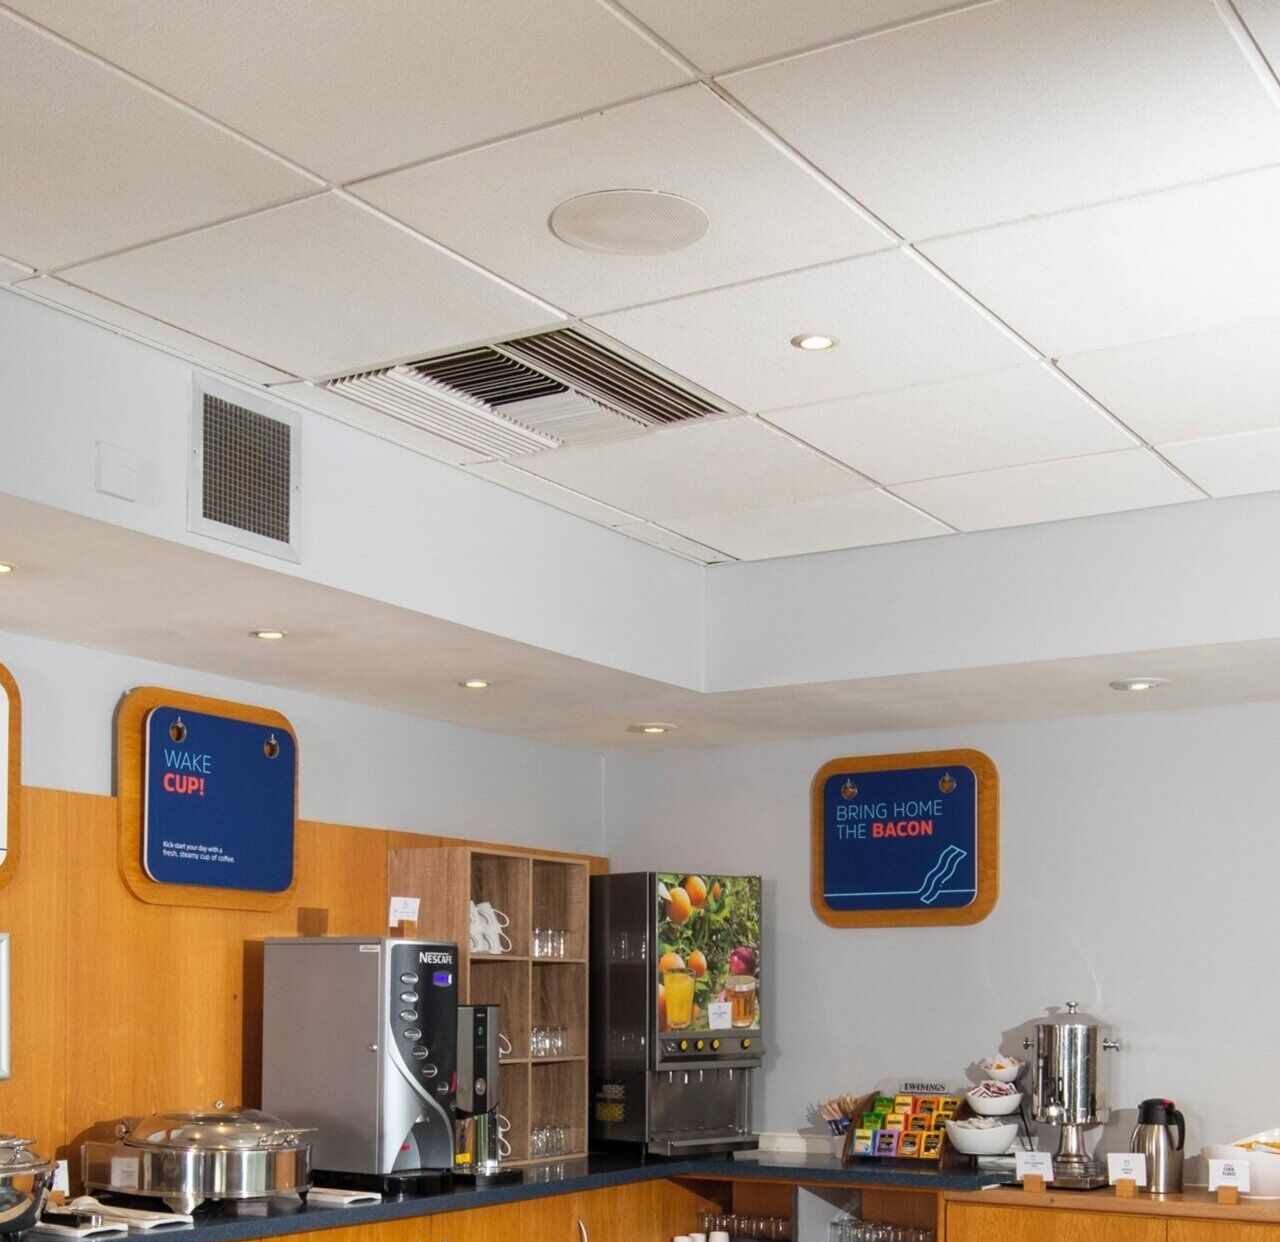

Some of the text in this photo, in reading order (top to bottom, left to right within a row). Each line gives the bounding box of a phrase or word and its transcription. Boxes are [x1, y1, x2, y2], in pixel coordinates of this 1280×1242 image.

[164, 748, 211, 774] WAKE
[163, 773, 205, 796] CUP!
[836, 800, 943, 821] BRING HOME
[836, 820, 933, 839] THE BACON
[186, 843, 198, 851] your
[198, 844, 207, 853] day
[200, 853, 210, 861] cup
[904, 1082, 946, 1092] TWININGS
